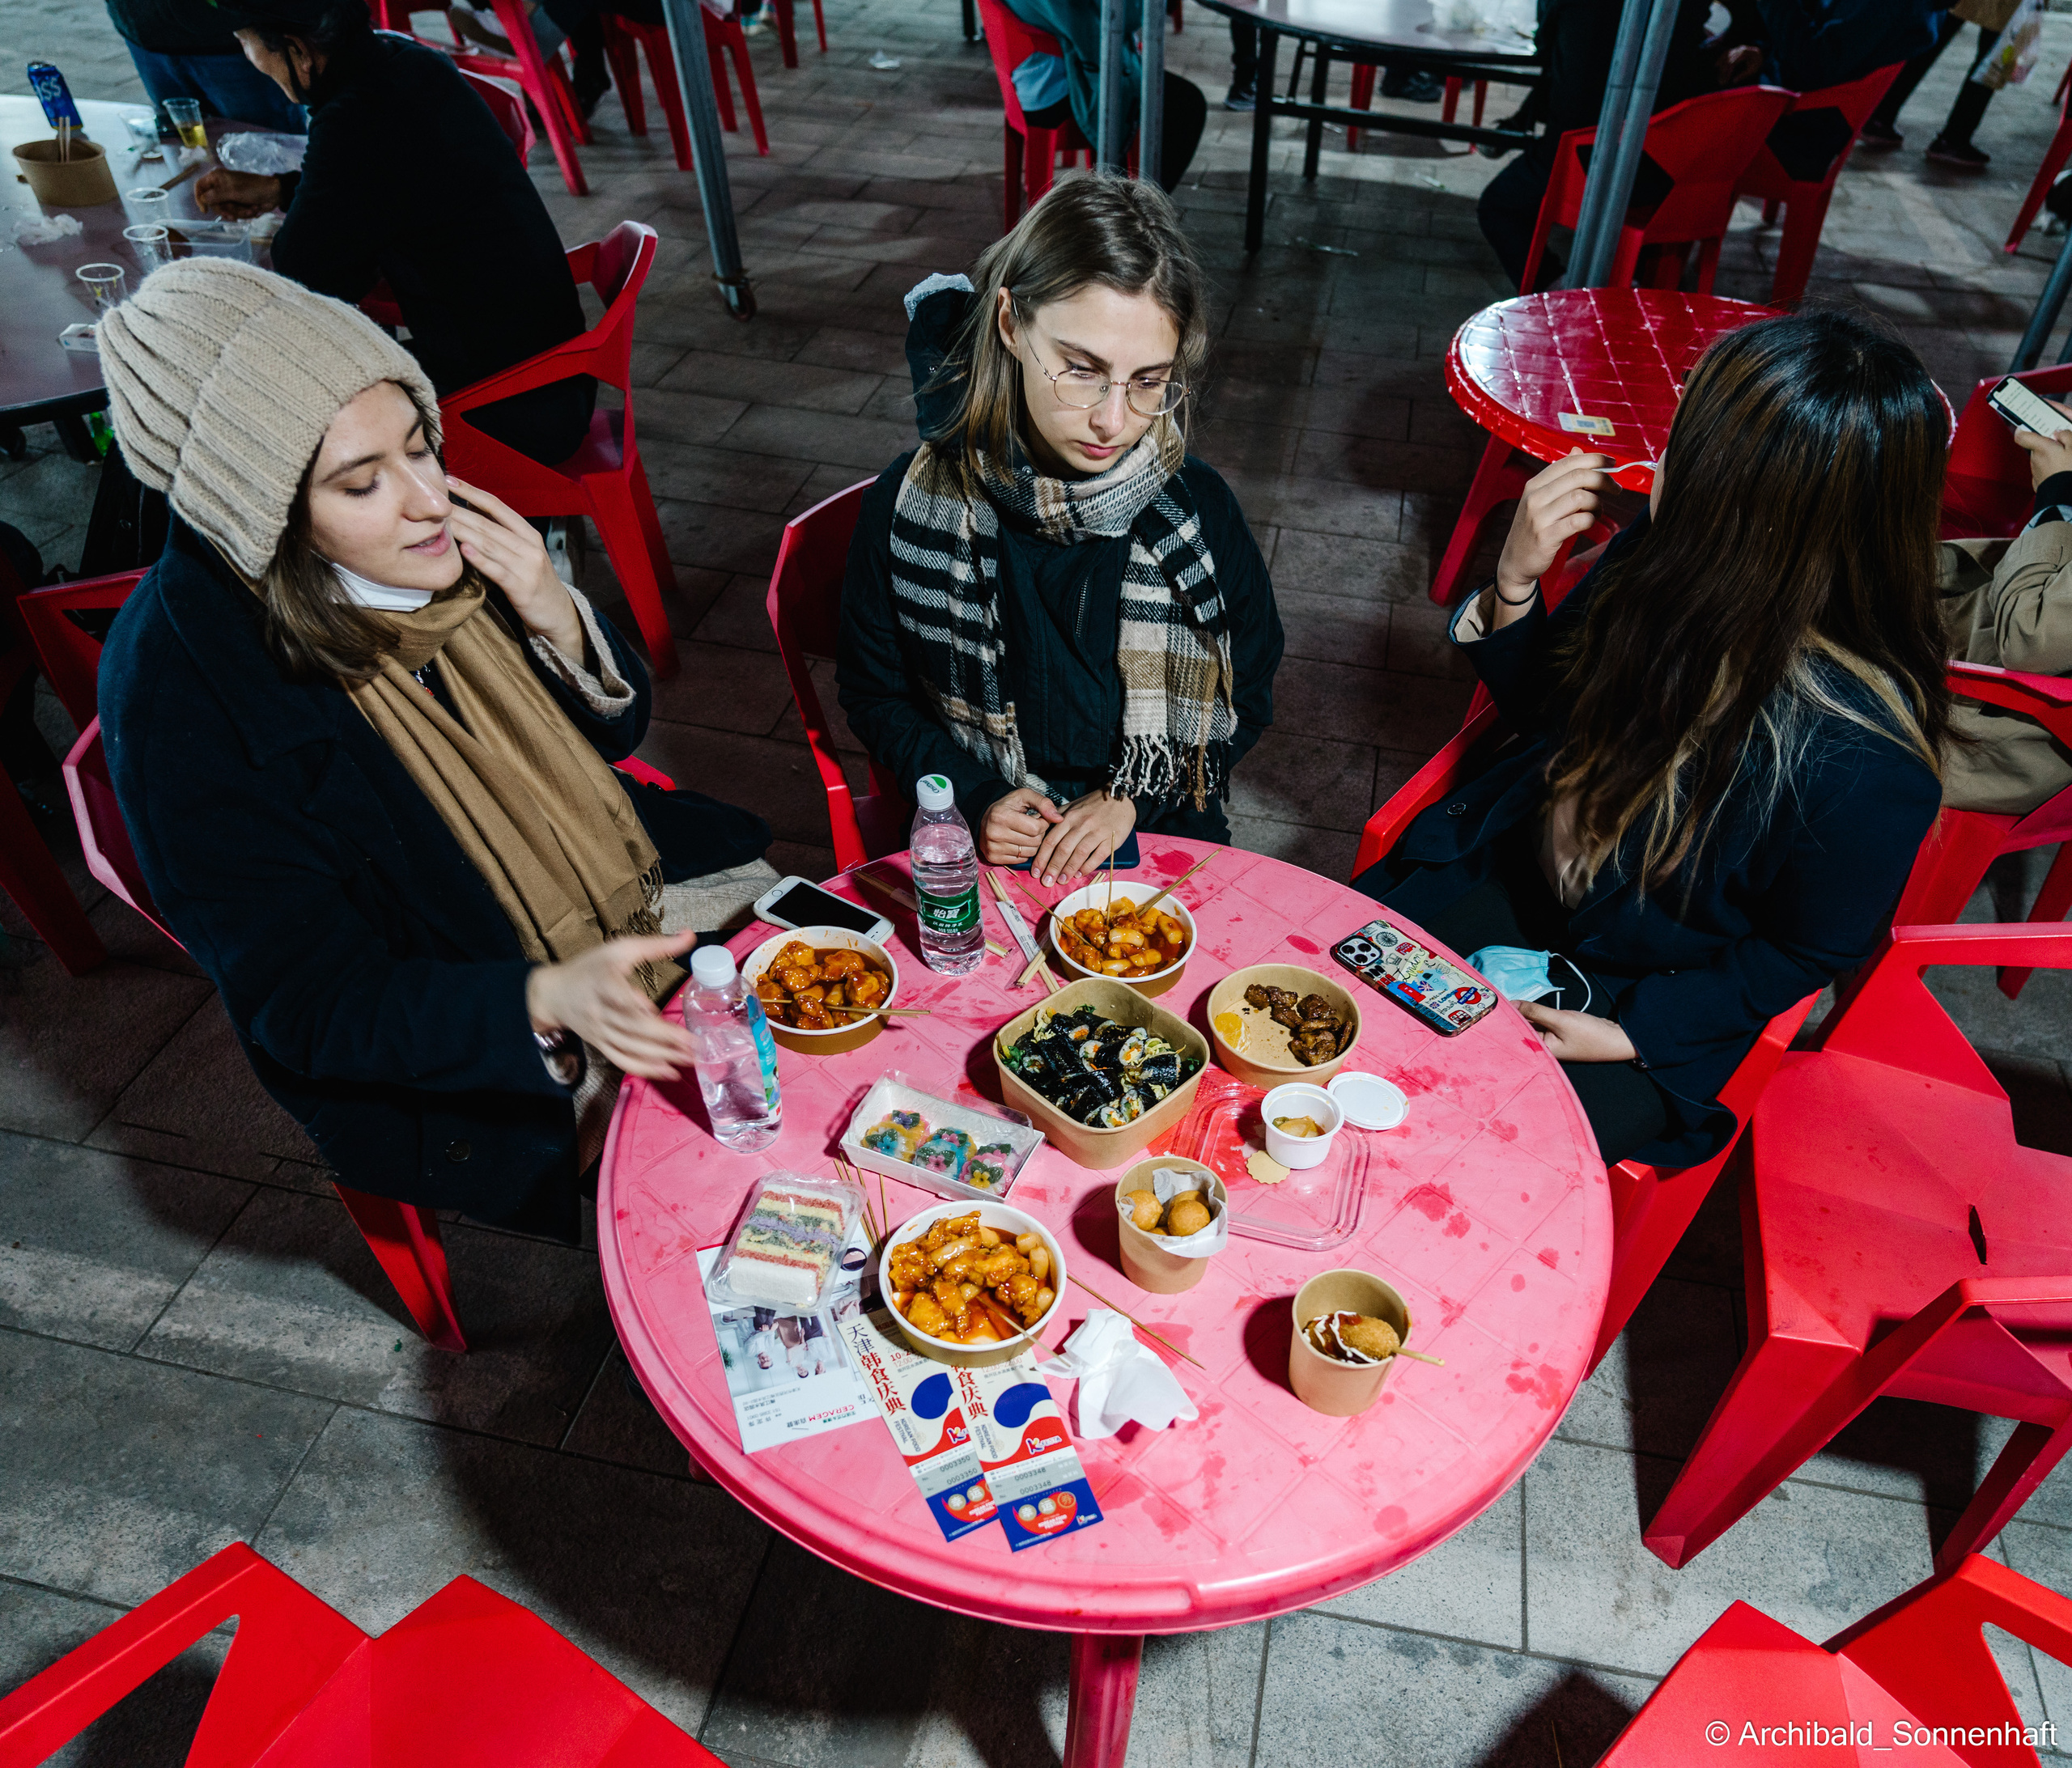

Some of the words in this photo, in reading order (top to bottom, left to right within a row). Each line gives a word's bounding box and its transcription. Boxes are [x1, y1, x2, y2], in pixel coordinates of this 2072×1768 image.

[847, 1324, 906, 1416] 天津韩食庆典
[809, 1404, 855, 1422] CERAGEM
[894, 1420, 908, 1444] FESTIVAL
[900, 1418, 913, 1439] KOREAN
[911, 1437, 921, 1452] FOOD
[974, 1426, 986, 1449] FESTIVAL
[981, 1423, 991, 1445] KOREAN
[989, 1444, 998, 1459] FOOD
[940, 1455, 971, 1473] 0003350
[946, 1467, 978, 1485] 0003350
[1014, 1467, 1047, 1482] 0003348
[1020, 1480, 1052, 1495] 0003348
